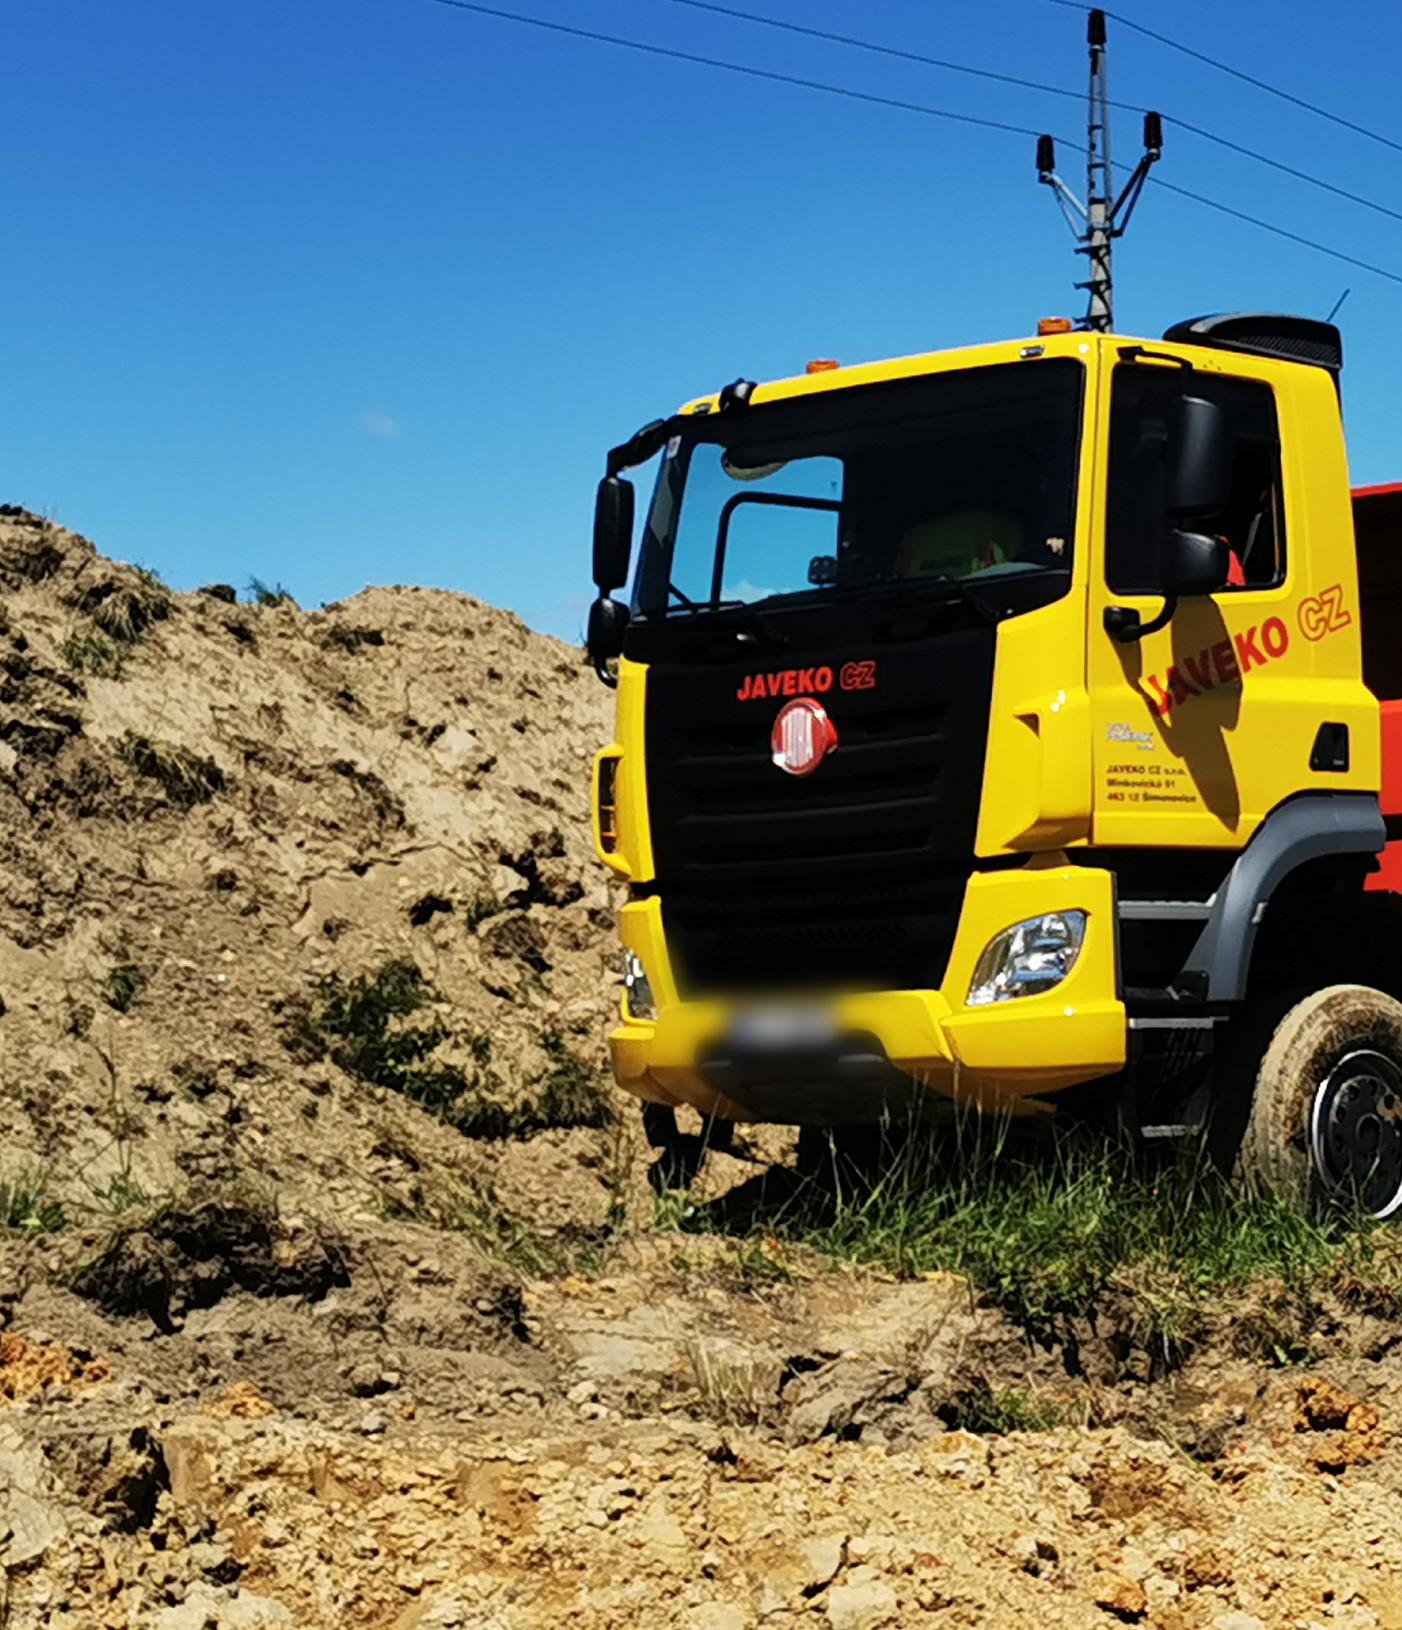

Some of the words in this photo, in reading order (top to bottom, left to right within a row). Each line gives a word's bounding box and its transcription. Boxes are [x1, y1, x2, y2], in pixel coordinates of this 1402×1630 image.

[737, 666, 834, 700] JAVEKO
[839, 661, 877, 690] CZ
[1147, 616, 1290, 718] JAVEKO
[1297, 584, 1352, 642] CZ
